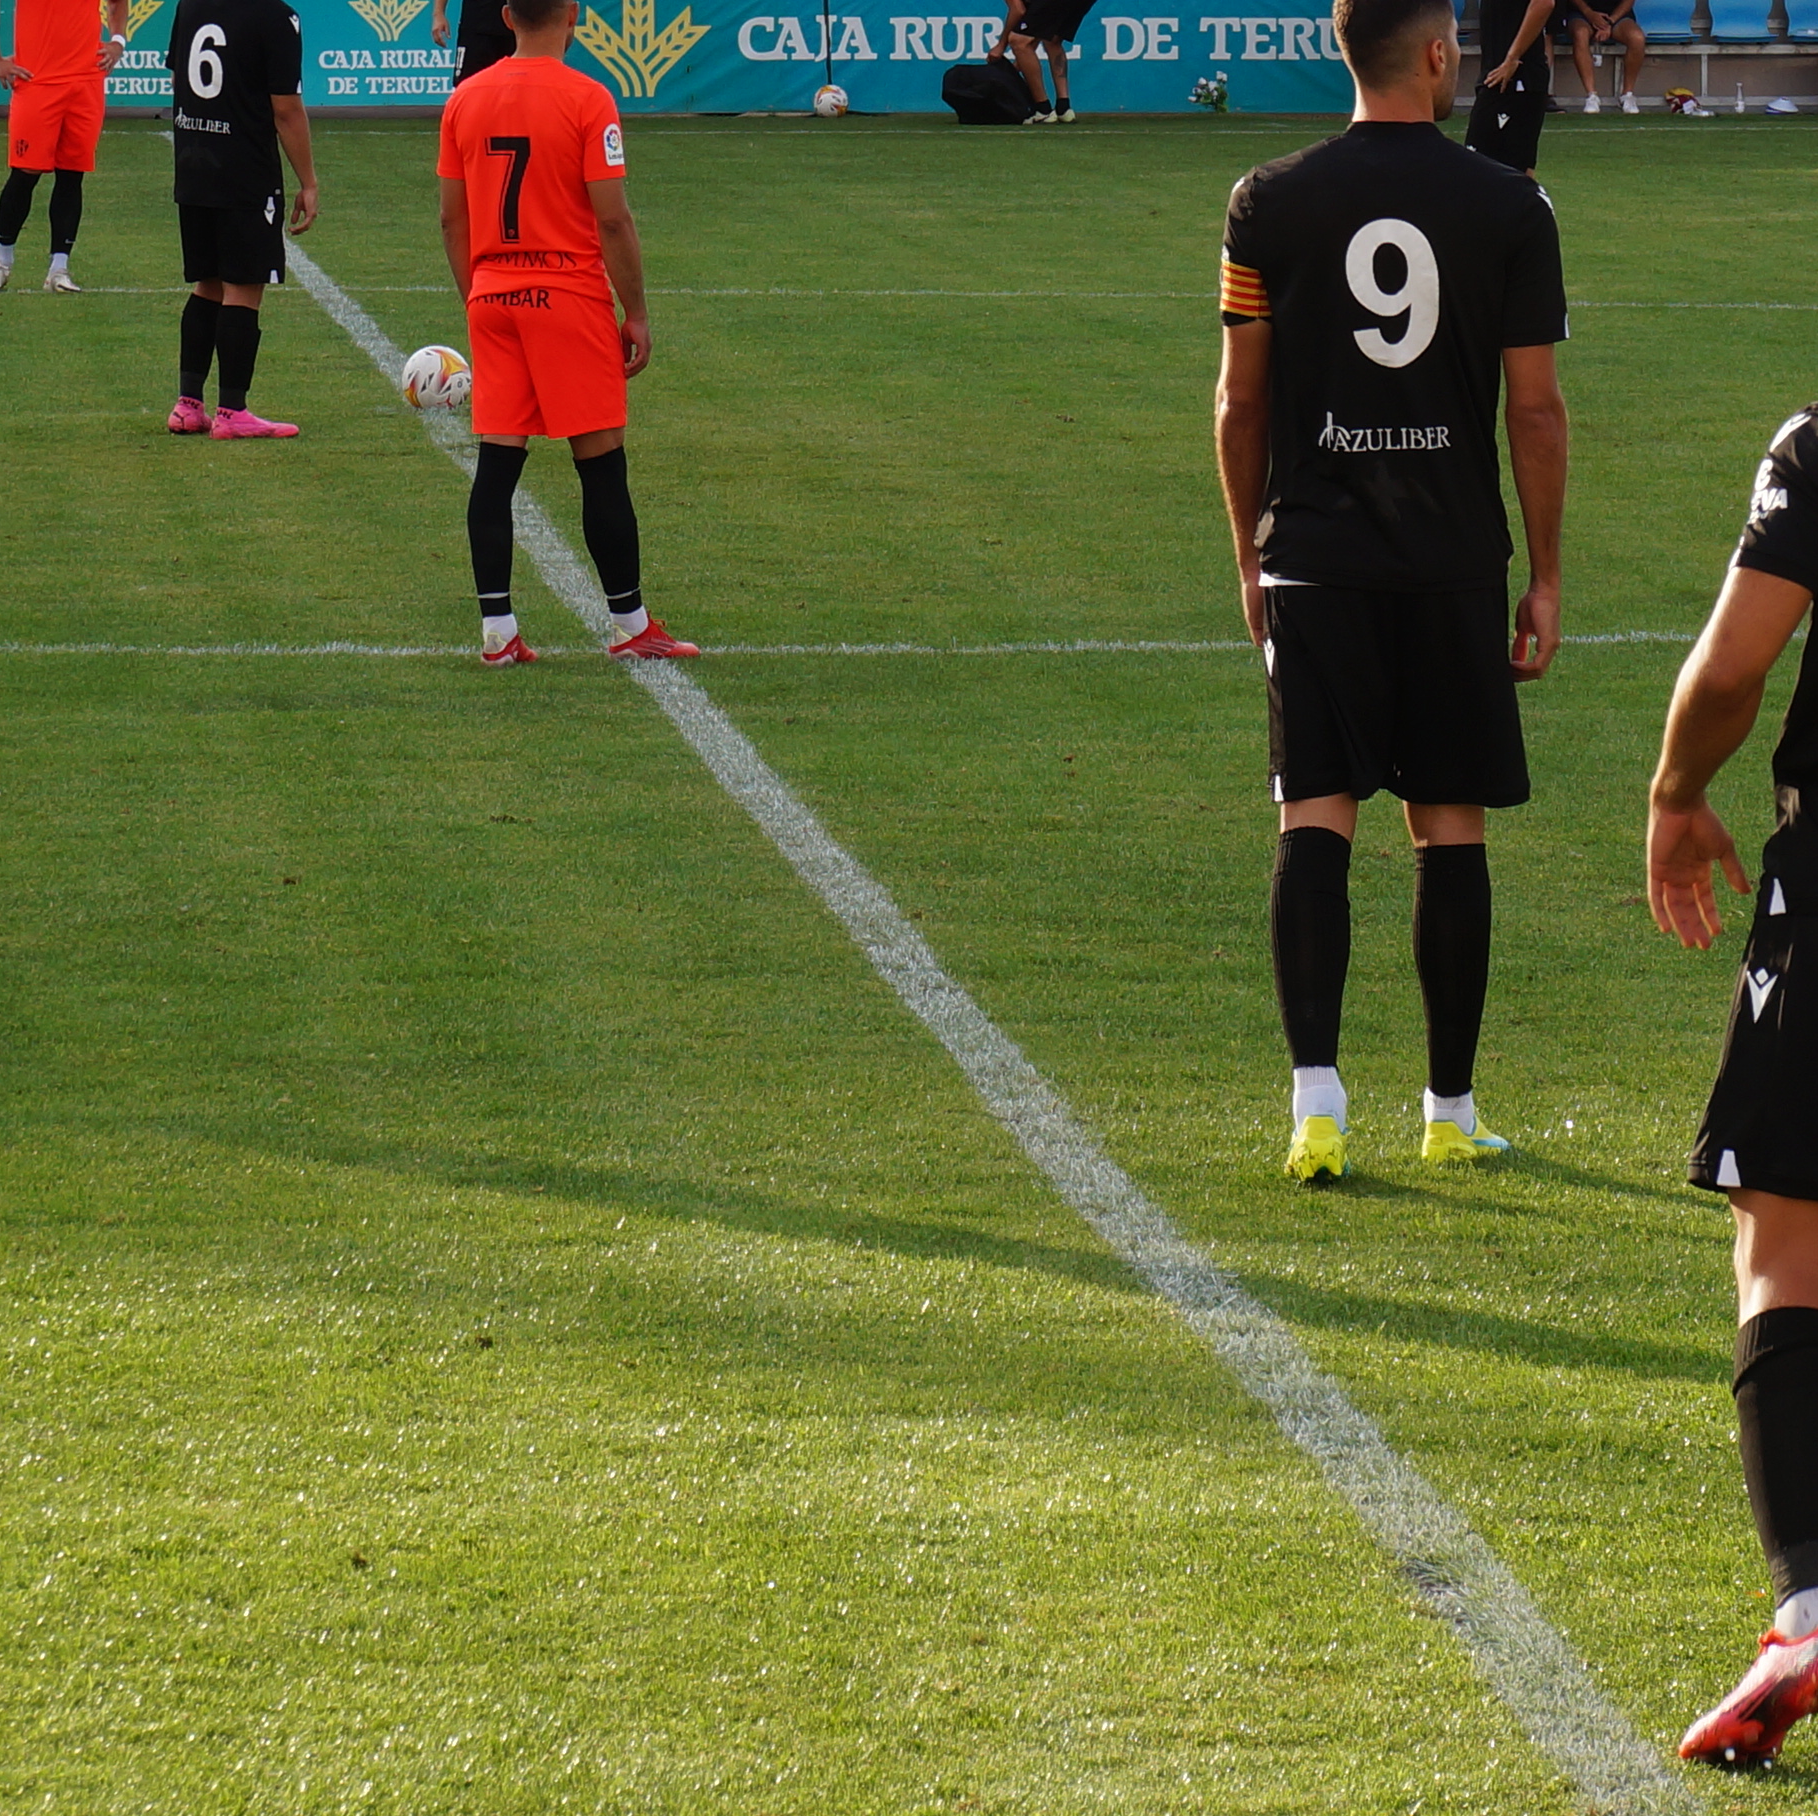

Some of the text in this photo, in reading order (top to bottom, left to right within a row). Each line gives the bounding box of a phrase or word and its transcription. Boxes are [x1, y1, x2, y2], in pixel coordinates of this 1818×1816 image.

[188, 23, 227, 100] 6
[318, 50, 456, 70] CAJA RURAL
[737, 14, 878, 62] CAJA
[1101, 17, 1179, 60] DE
[327, 77, 456, 95] DE TERUEL
[485, 137, 531, 244] 7
[1345, 218, 1440, 368] 9
